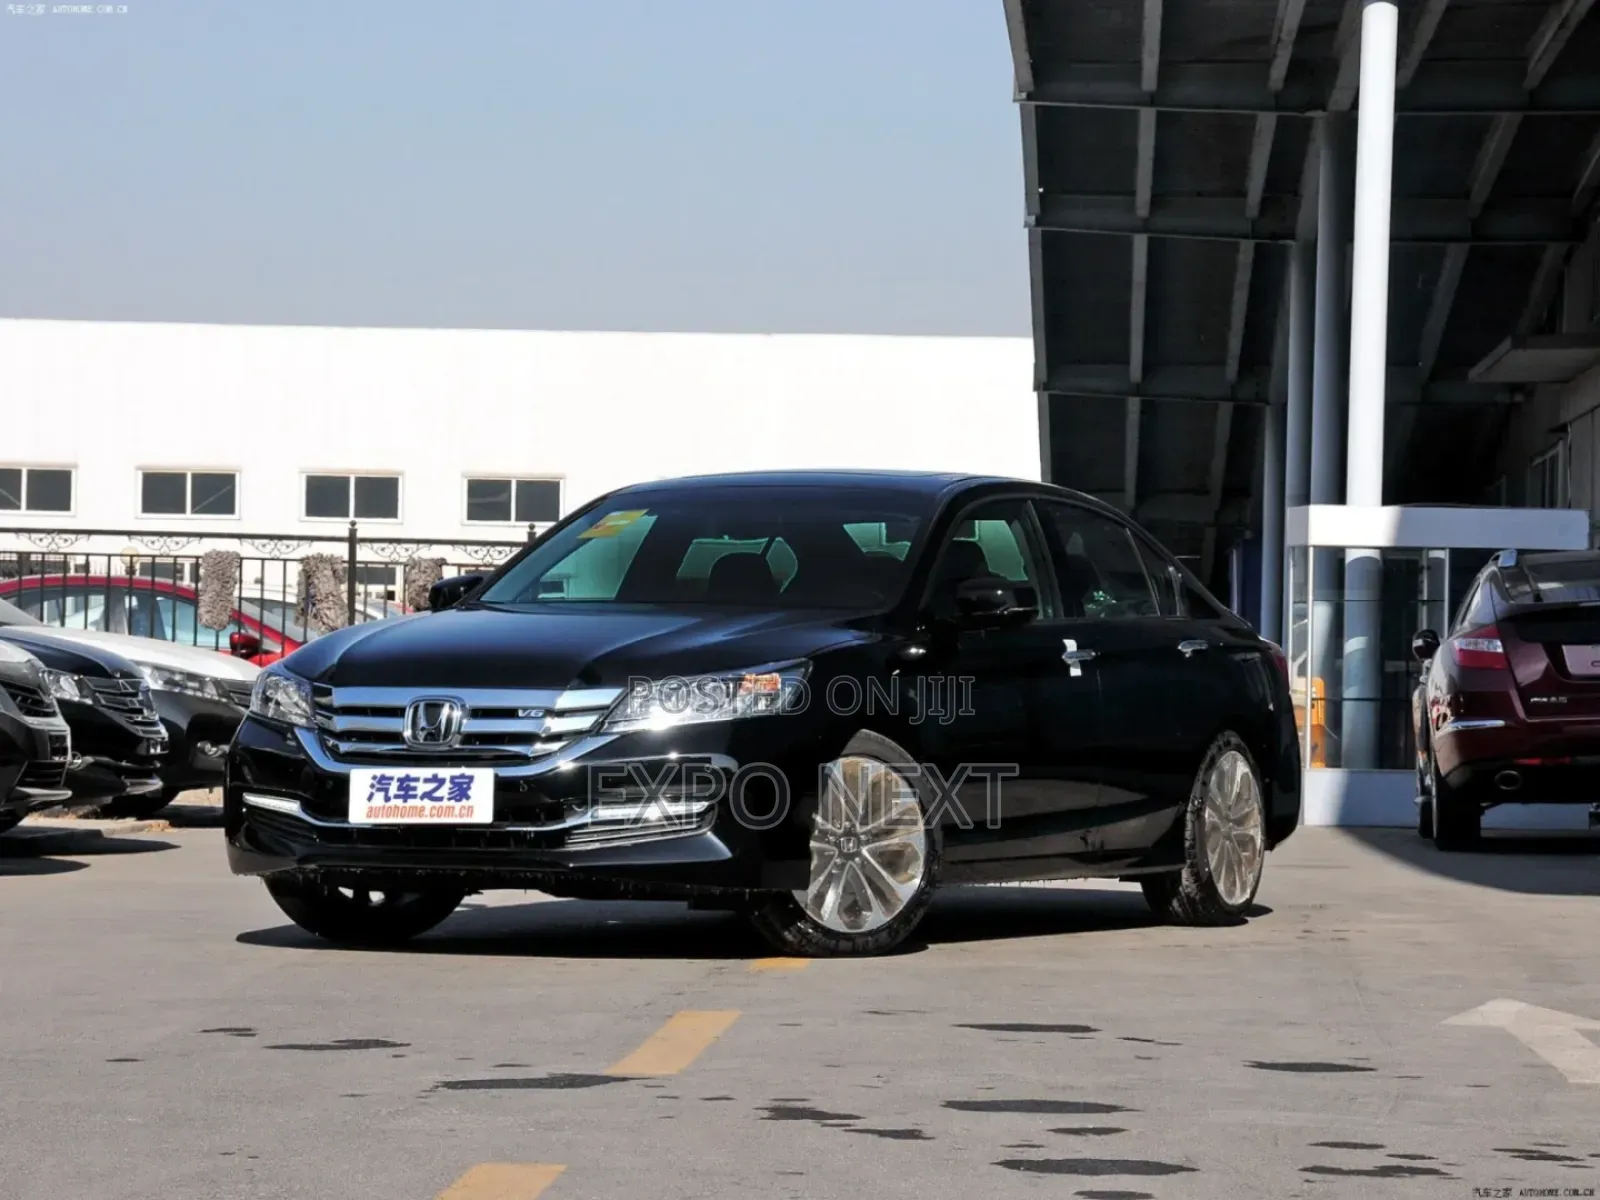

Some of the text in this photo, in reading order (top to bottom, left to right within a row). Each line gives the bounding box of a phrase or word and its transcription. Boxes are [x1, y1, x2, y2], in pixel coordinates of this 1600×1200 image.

[518, 709, 545, 718] V6
[366, 773, 475, 804] 汽车之家
[366, 804, 475, 819] autohome.com.cn
